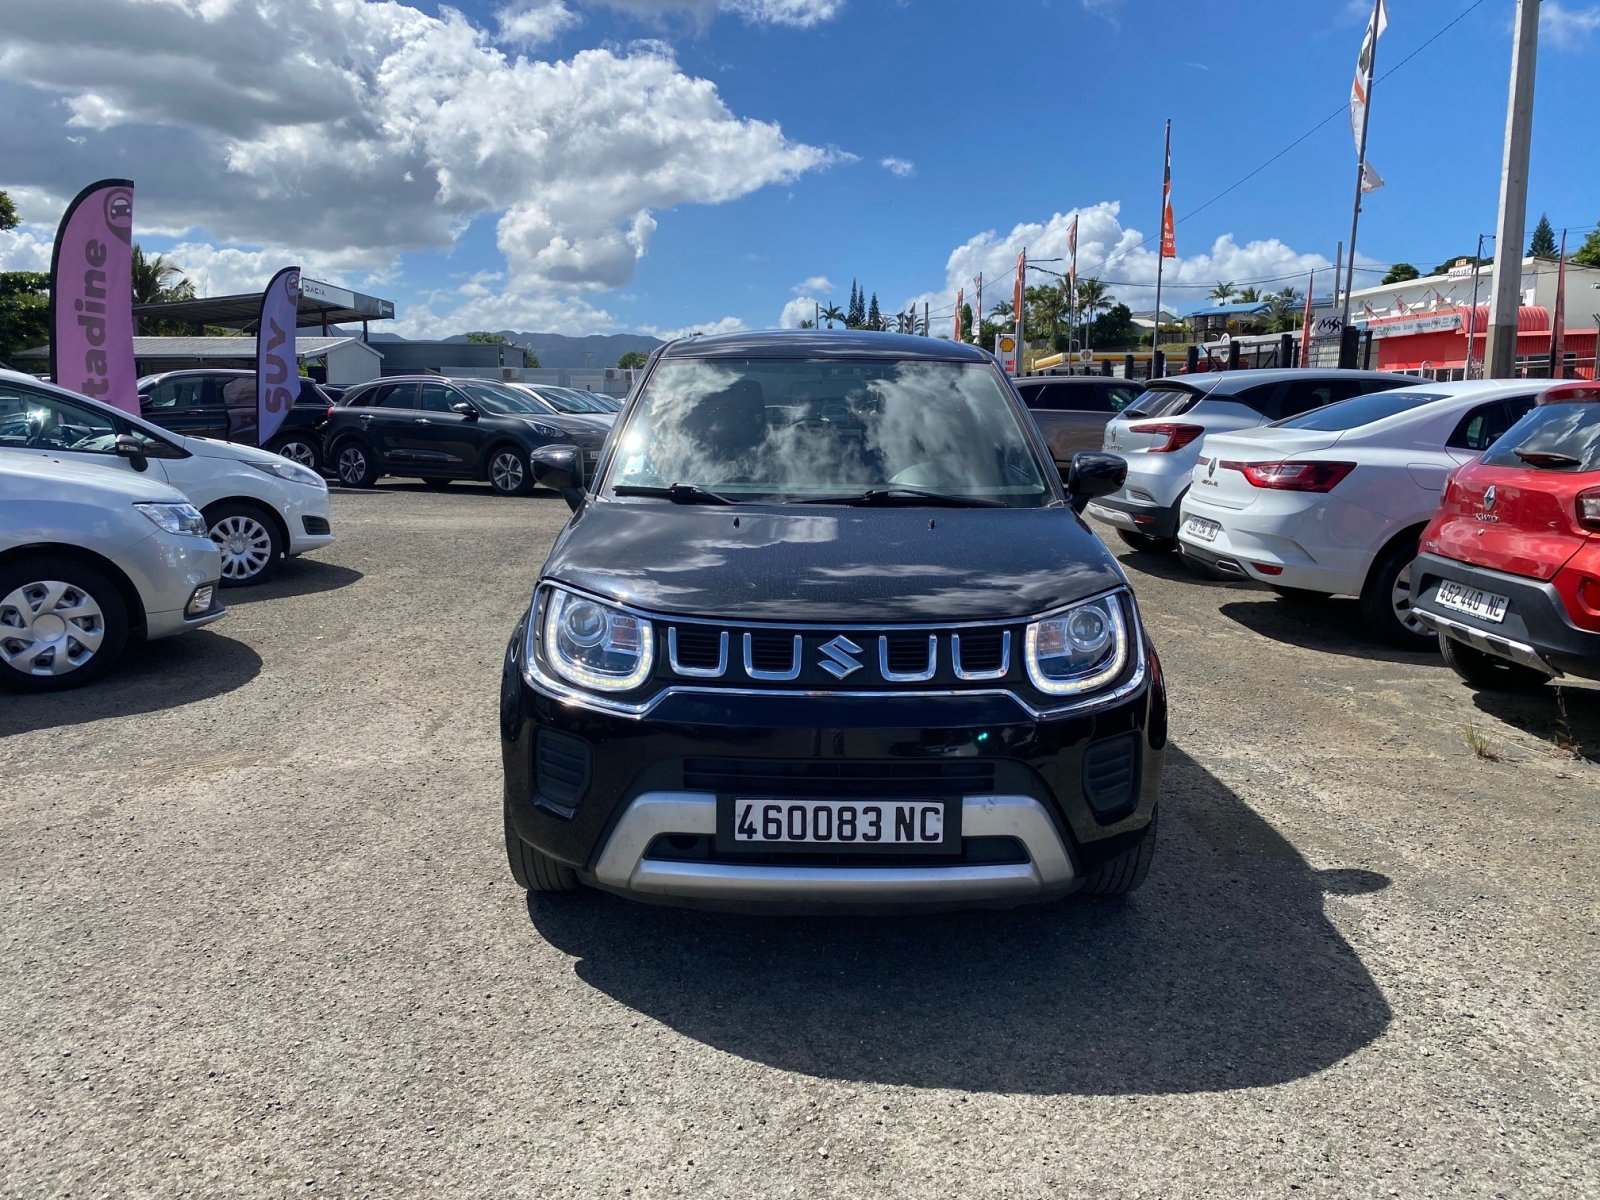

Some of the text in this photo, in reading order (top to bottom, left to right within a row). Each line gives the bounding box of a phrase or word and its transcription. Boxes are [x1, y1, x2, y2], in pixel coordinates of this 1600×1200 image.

[74, 239, 110, 403] tadine
[265, 317, 294, 414] SUV
[1440, 582, 1461, 604] 462
[1460, 588, 1484, 611] 440
[1485, 595, 1505, 617] NC
[737, 804, 941, 841] 460083 NC
